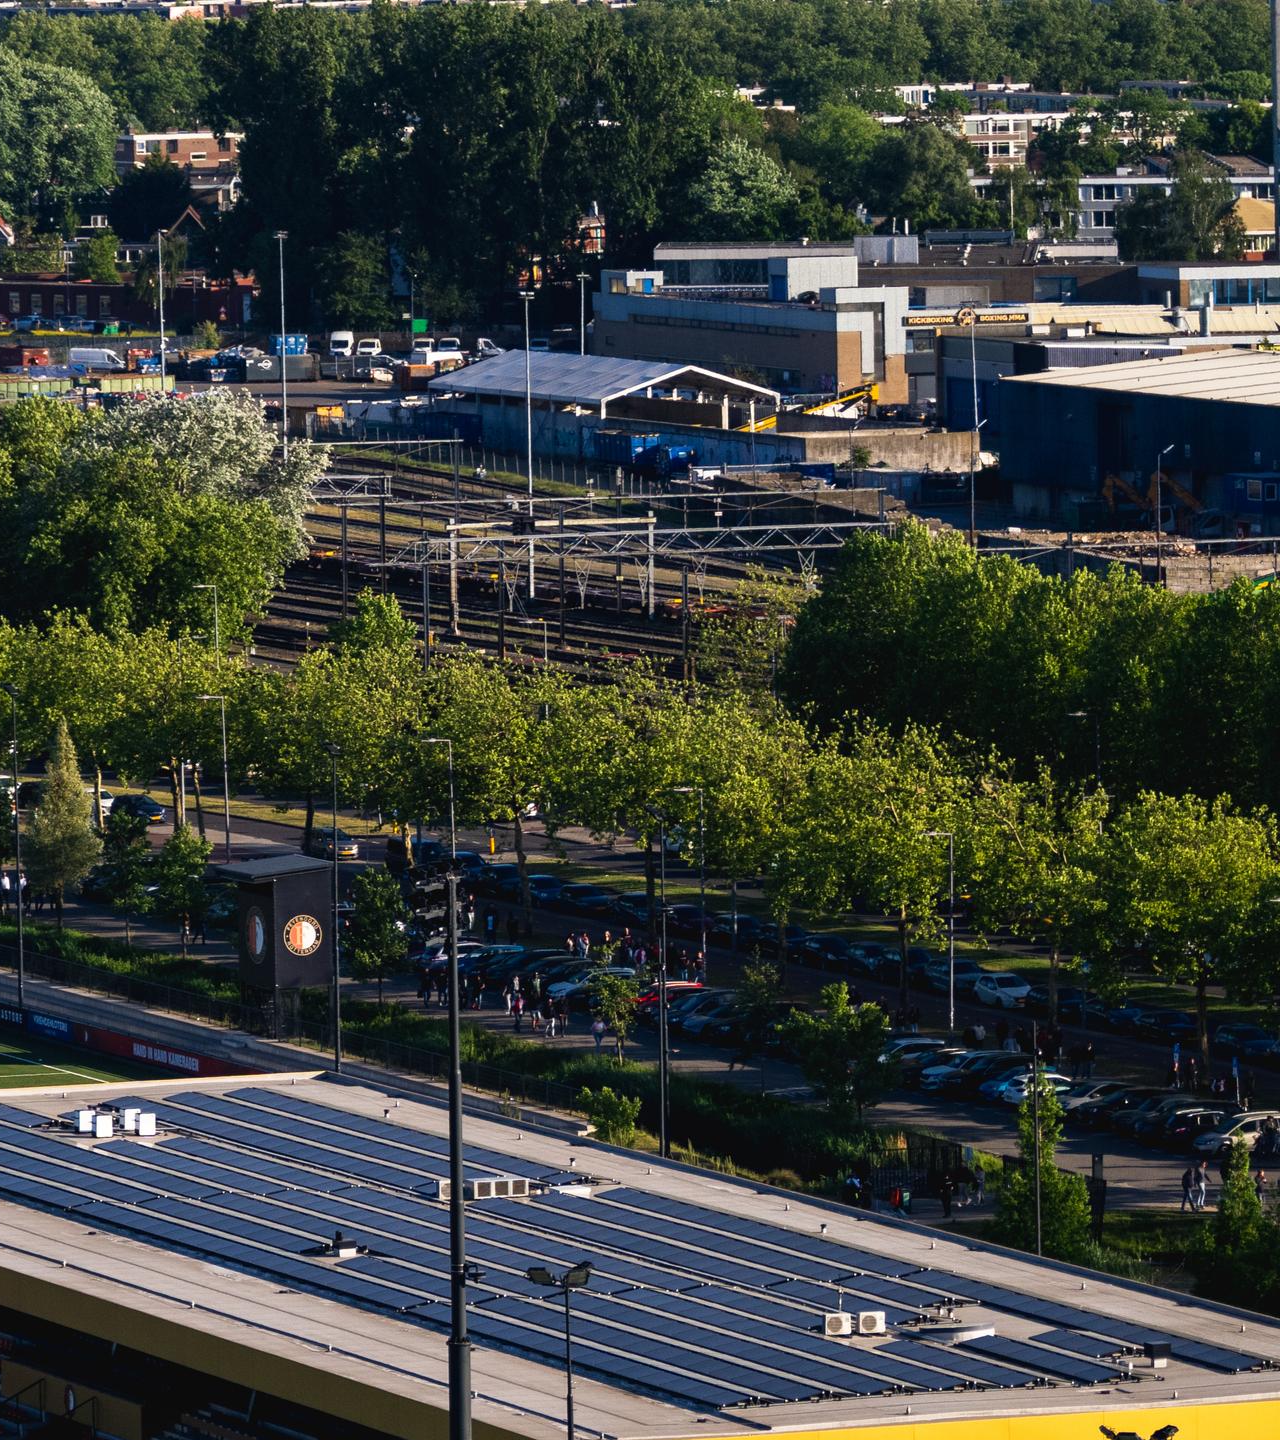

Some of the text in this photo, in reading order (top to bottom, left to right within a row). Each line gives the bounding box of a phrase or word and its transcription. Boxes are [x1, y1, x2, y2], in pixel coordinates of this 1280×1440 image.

[908, 316, 954, 325] KICKBOXING
[980, 314, 1026, 324] BOXING MMA
